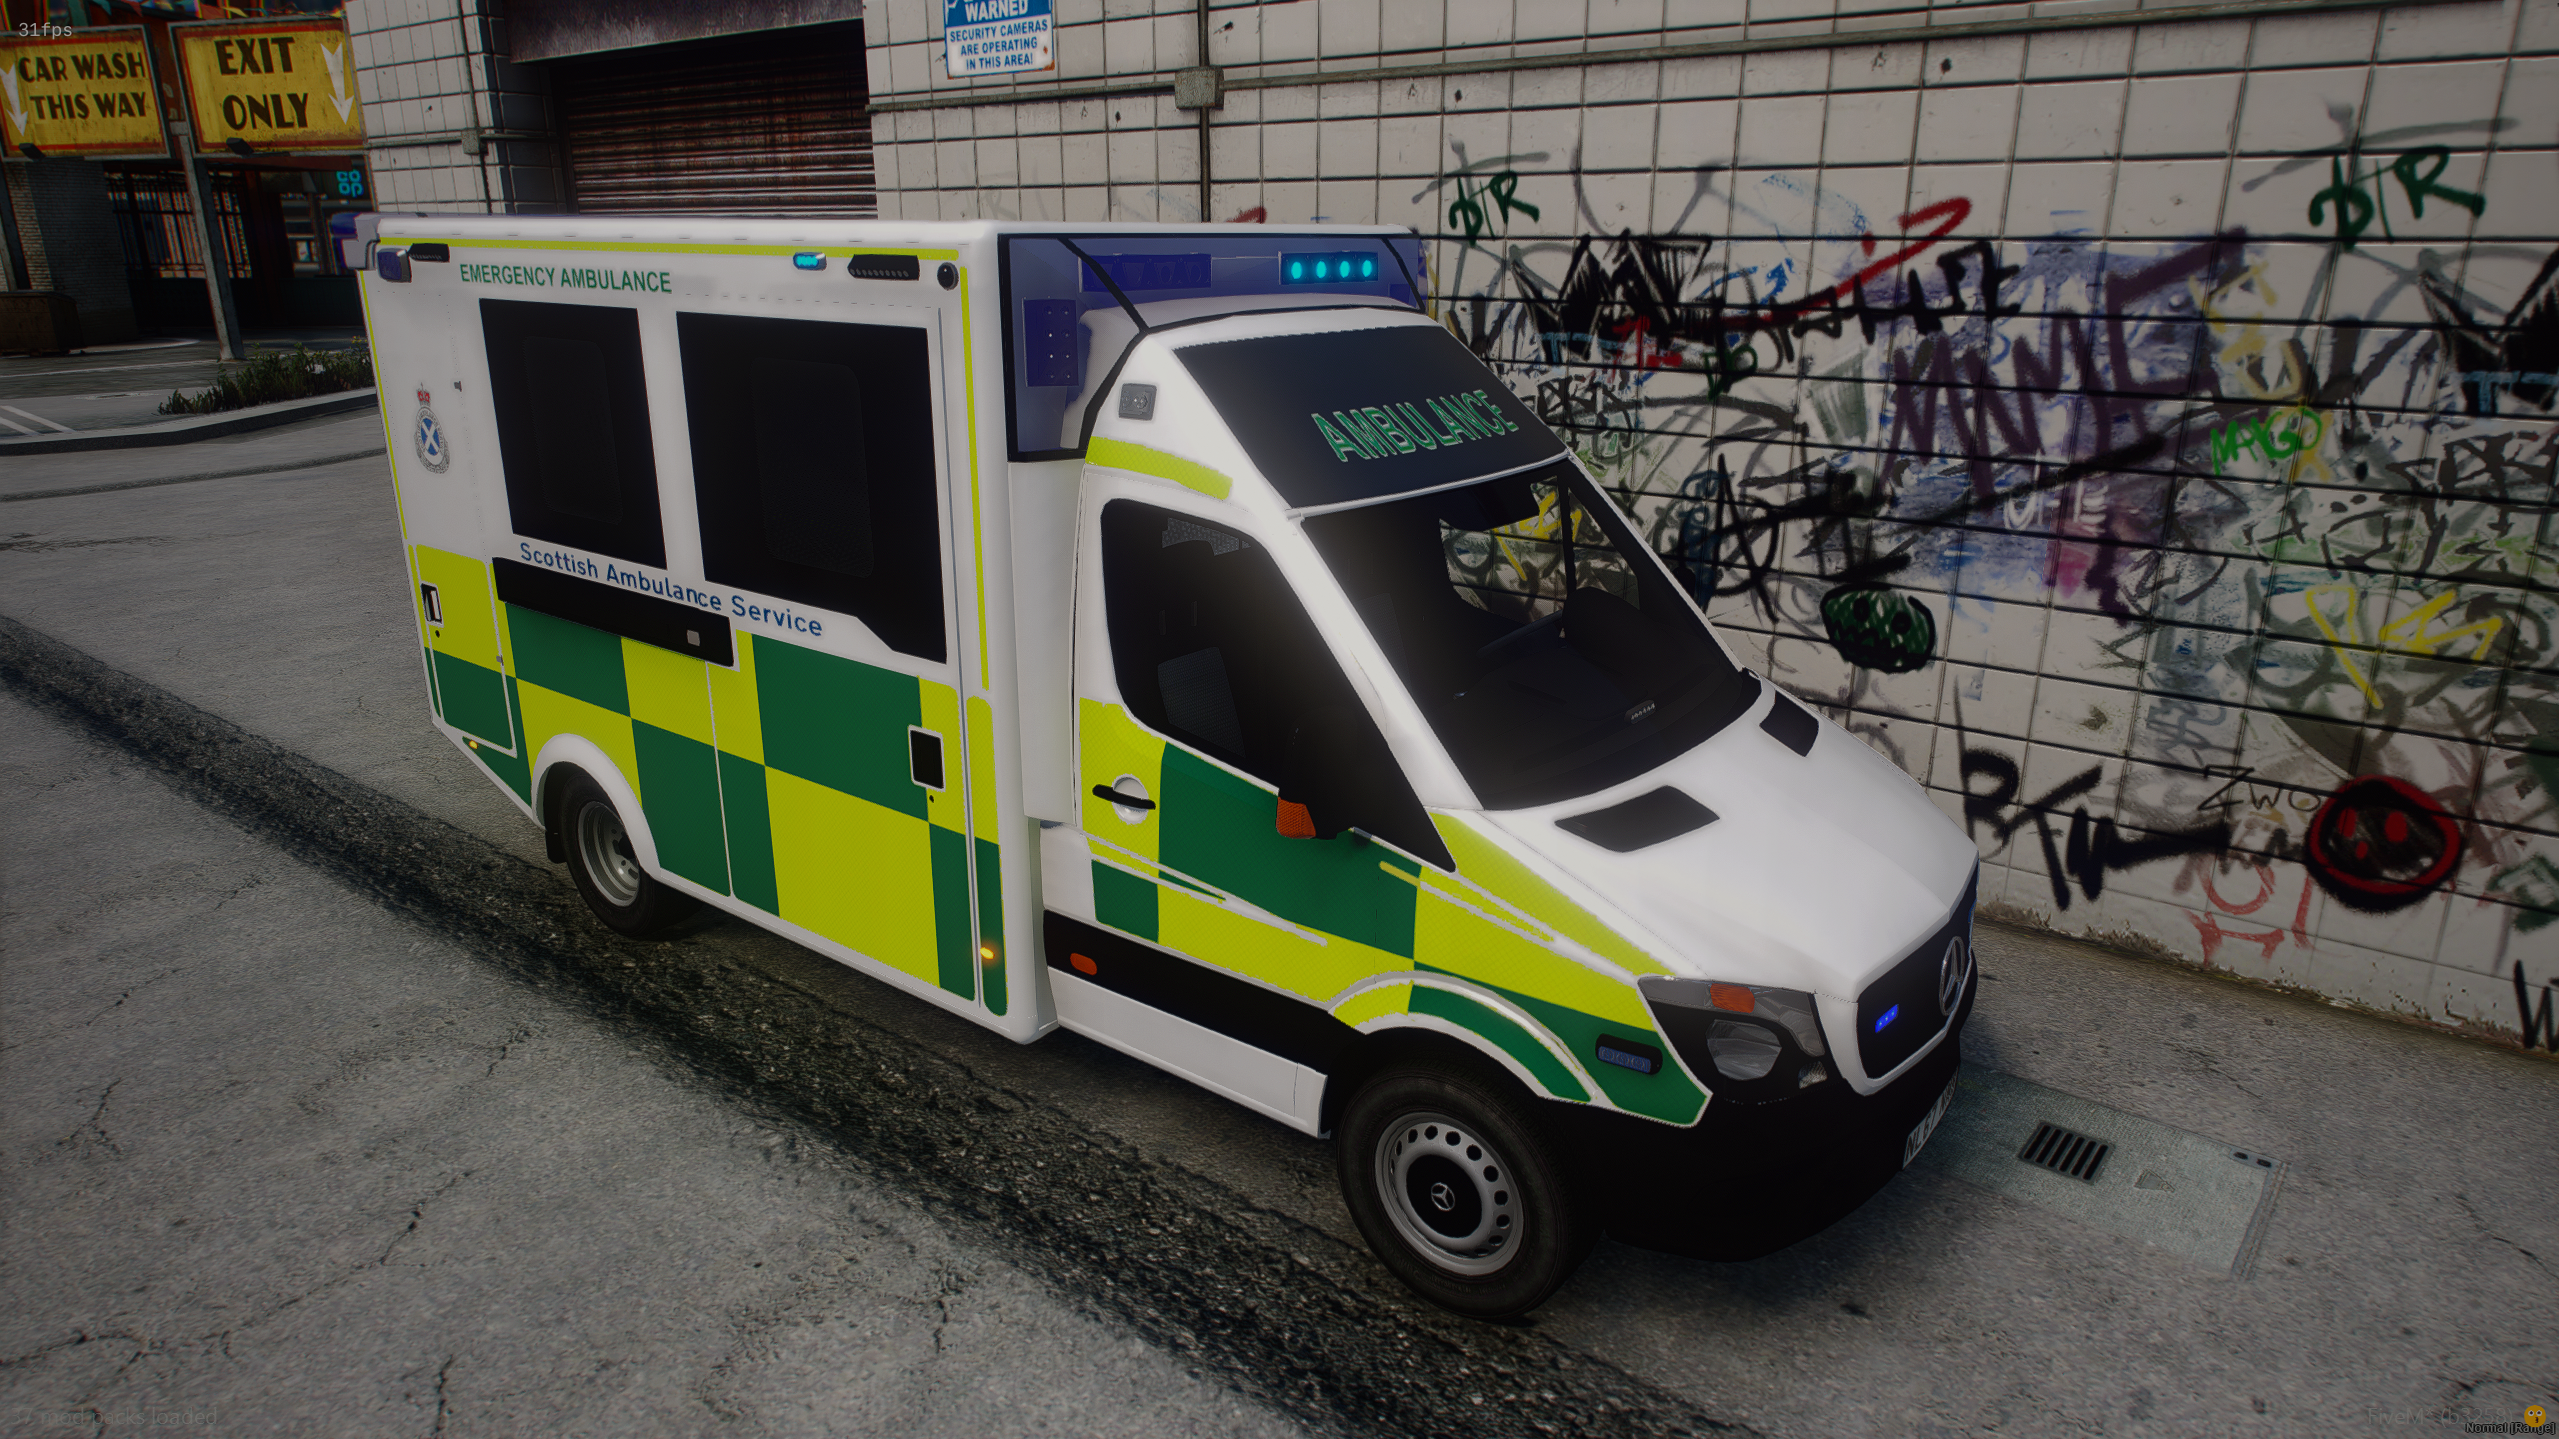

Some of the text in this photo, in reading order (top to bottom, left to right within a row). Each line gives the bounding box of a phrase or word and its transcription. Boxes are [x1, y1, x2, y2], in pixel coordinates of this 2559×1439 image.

[964, 0, 1029, 22] WARNED
[950, 19, 1048, 43] SECURITY CAMERAS
[213, 36, 296, 76] EXIT
[960, 36, 1038, 57] ARE OPERATING
[18, 51, 146, 83] CAR WASH
[966, 53, 1034, 71] IN THIS AREA!
[29, 91, 147, 120] THIS WAY
[222, 92, 309, 131] ONLY
[459, 263, 673, 293] EMERGENCY AMBULANCE
[1311, 389, 1520, 463] AMBULANCE
[519, 542, 823, 637] Scottish Ambulance Service
